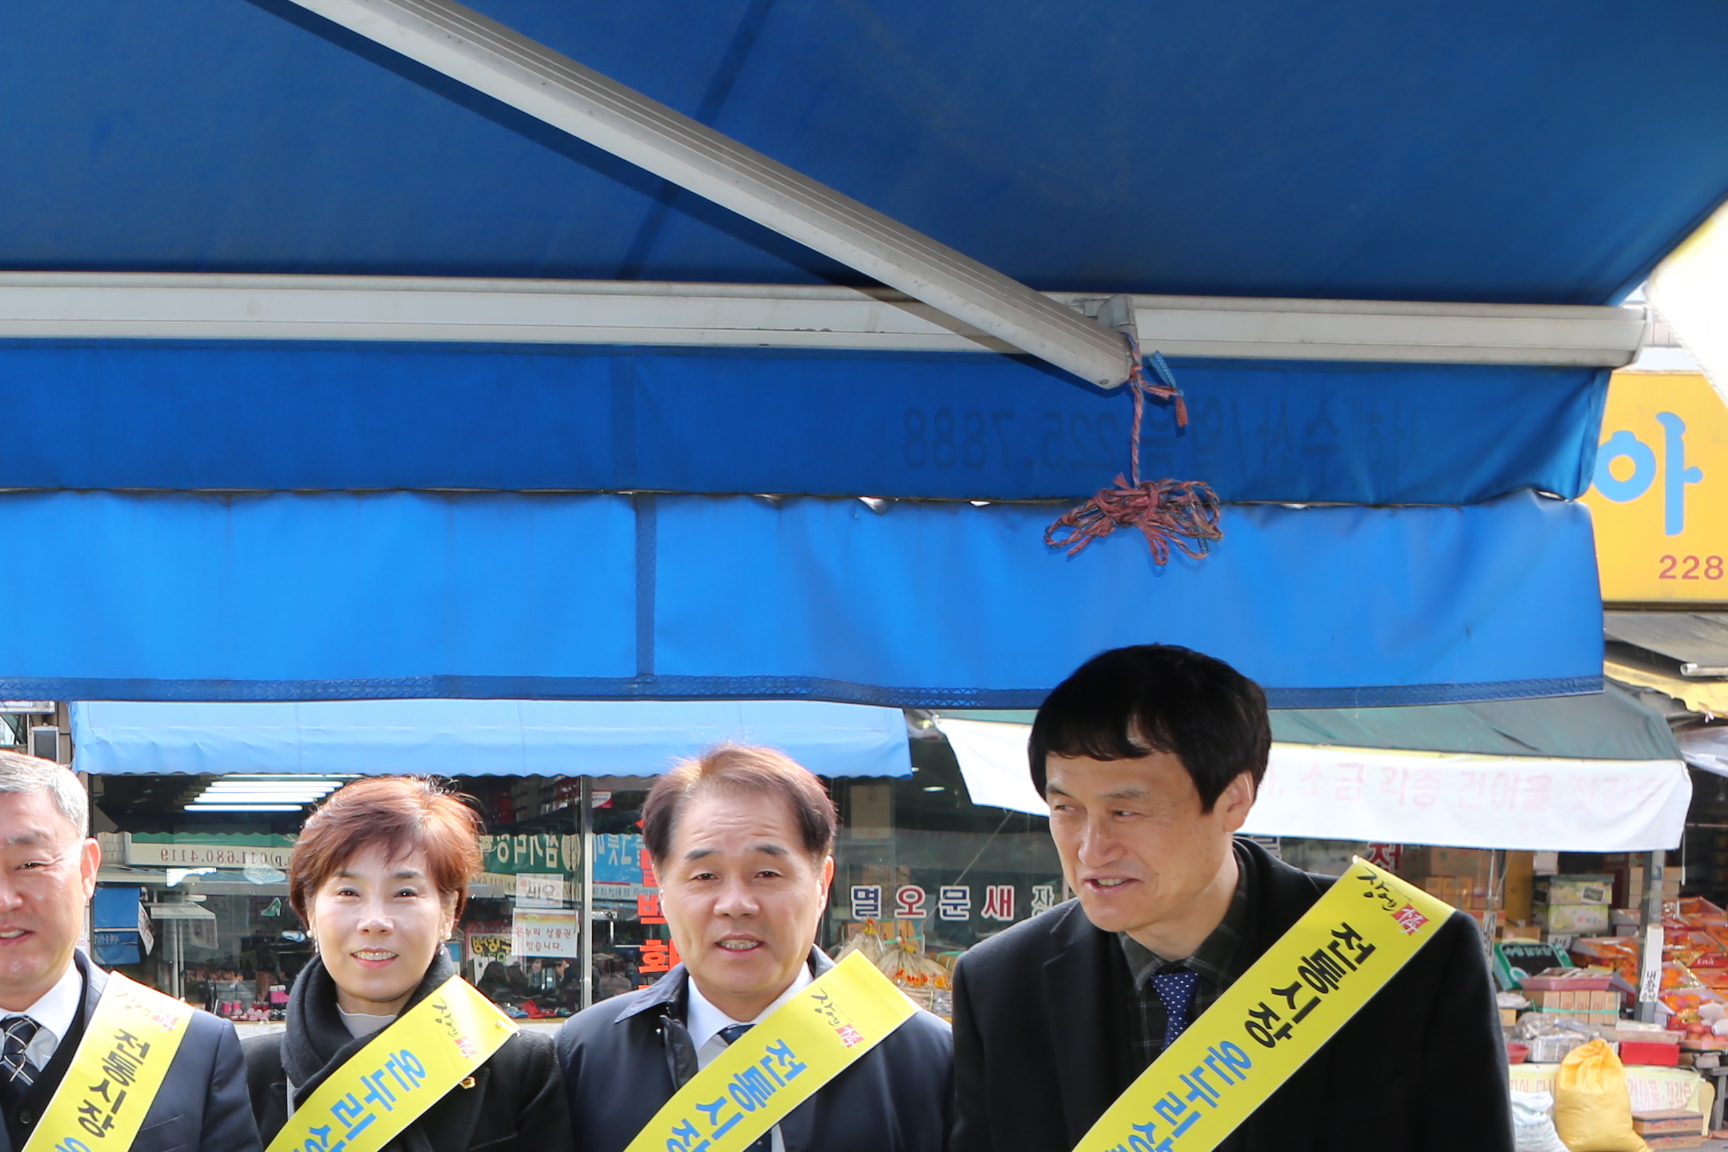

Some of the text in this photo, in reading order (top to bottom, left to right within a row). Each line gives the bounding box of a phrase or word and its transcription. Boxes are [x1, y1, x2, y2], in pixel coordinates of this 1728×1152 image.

[851, 885, 882, 920] 멸
[894, 885, 927, 919] 오
[939, 886, 971, 920] 문
[981, 886, 1014, 920] 새
[1245, 921, 1377, 1049] 전통시장
[76, 1027, 152, 1140] 전통시장
